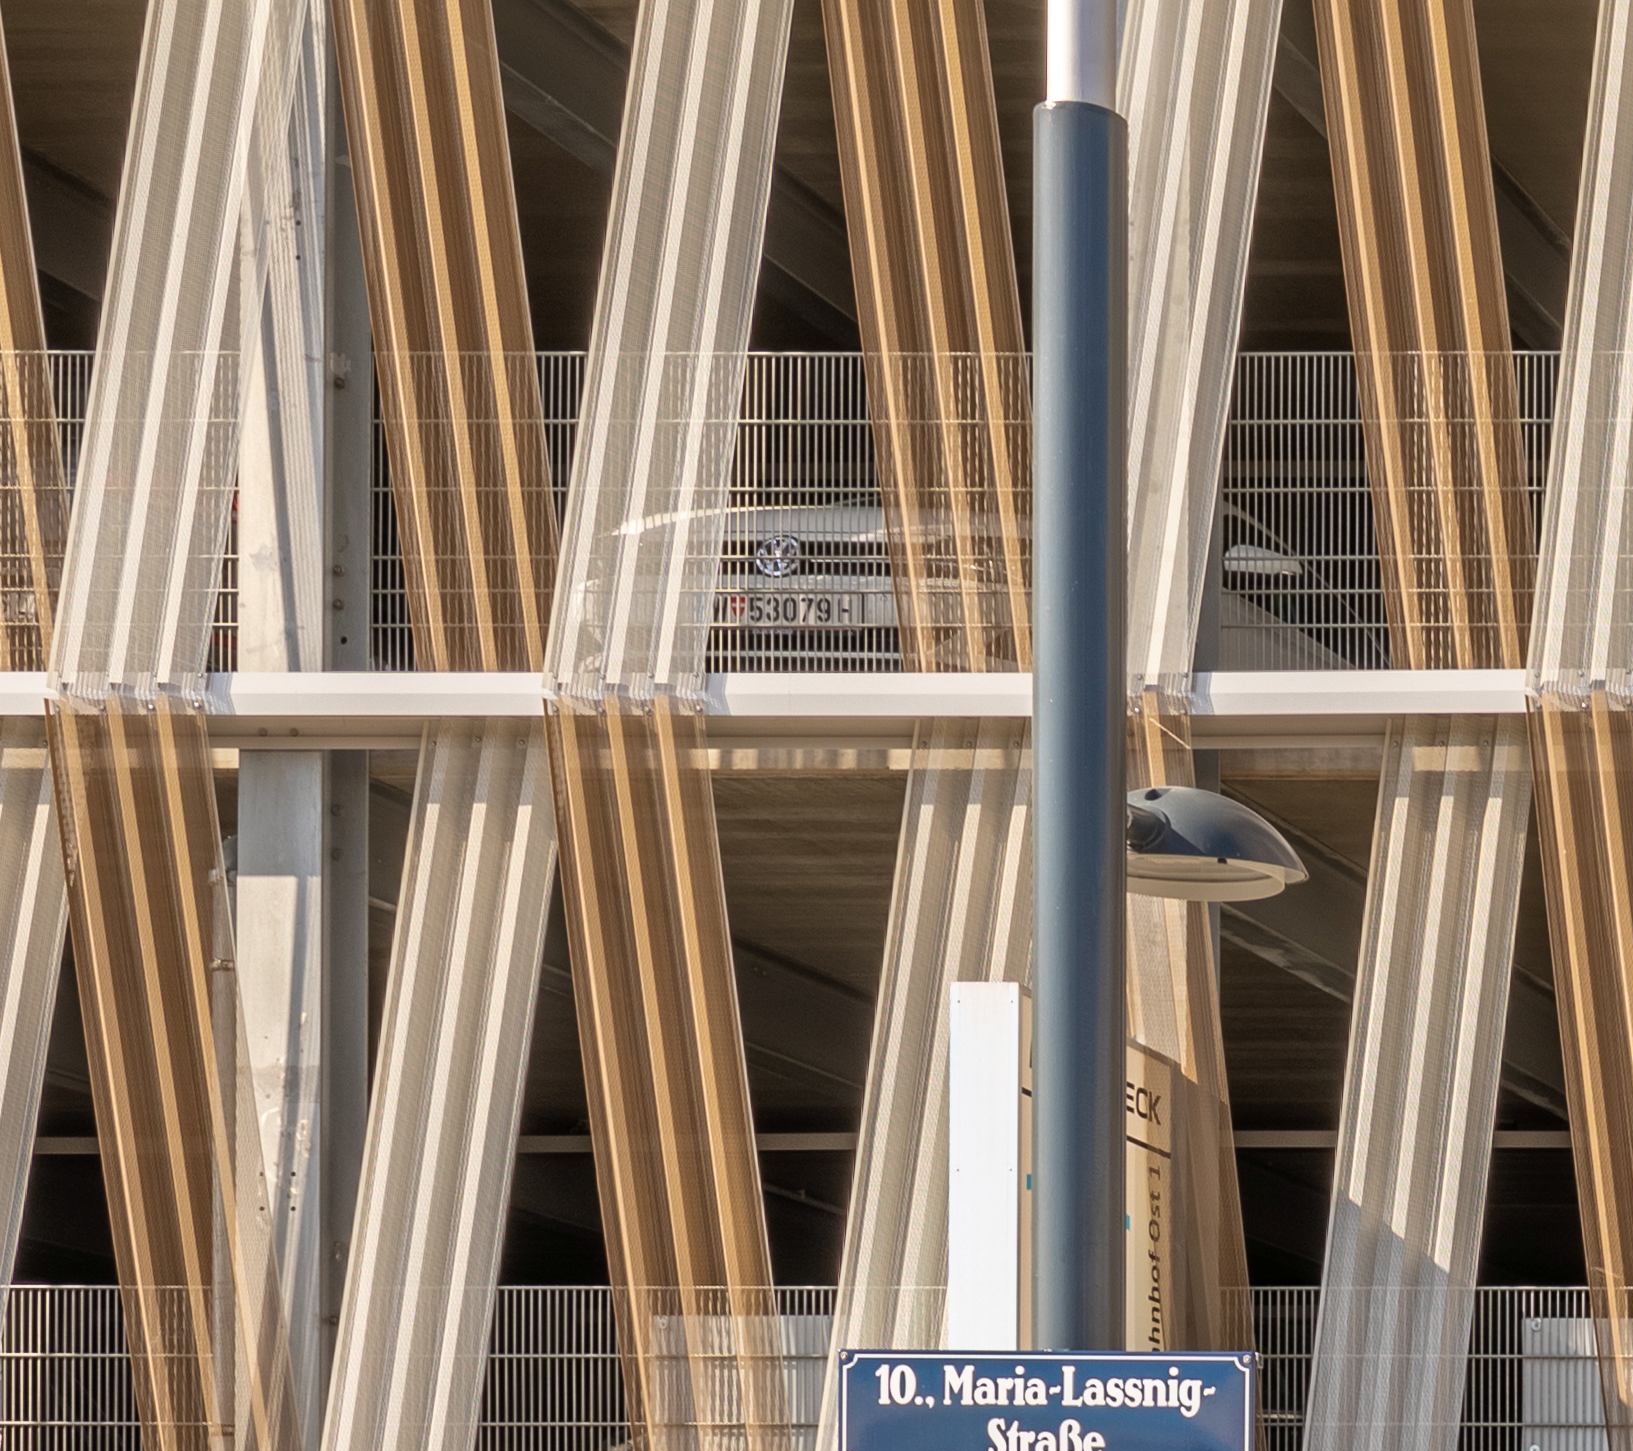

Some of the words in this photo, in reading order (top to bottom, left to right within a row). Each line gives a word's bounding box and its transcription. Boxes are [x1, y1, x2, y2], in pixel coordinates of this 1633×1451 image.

[1126, 1081, 1161, 1126] ECK
[1149, 1166, 1160, 1180] 1
[1149, 1192, 1160, 1242] Ost
[875, 1364, 934, 1408] 10.,
[943, 1364, 1216, 1418] Maria-Lassnig-
